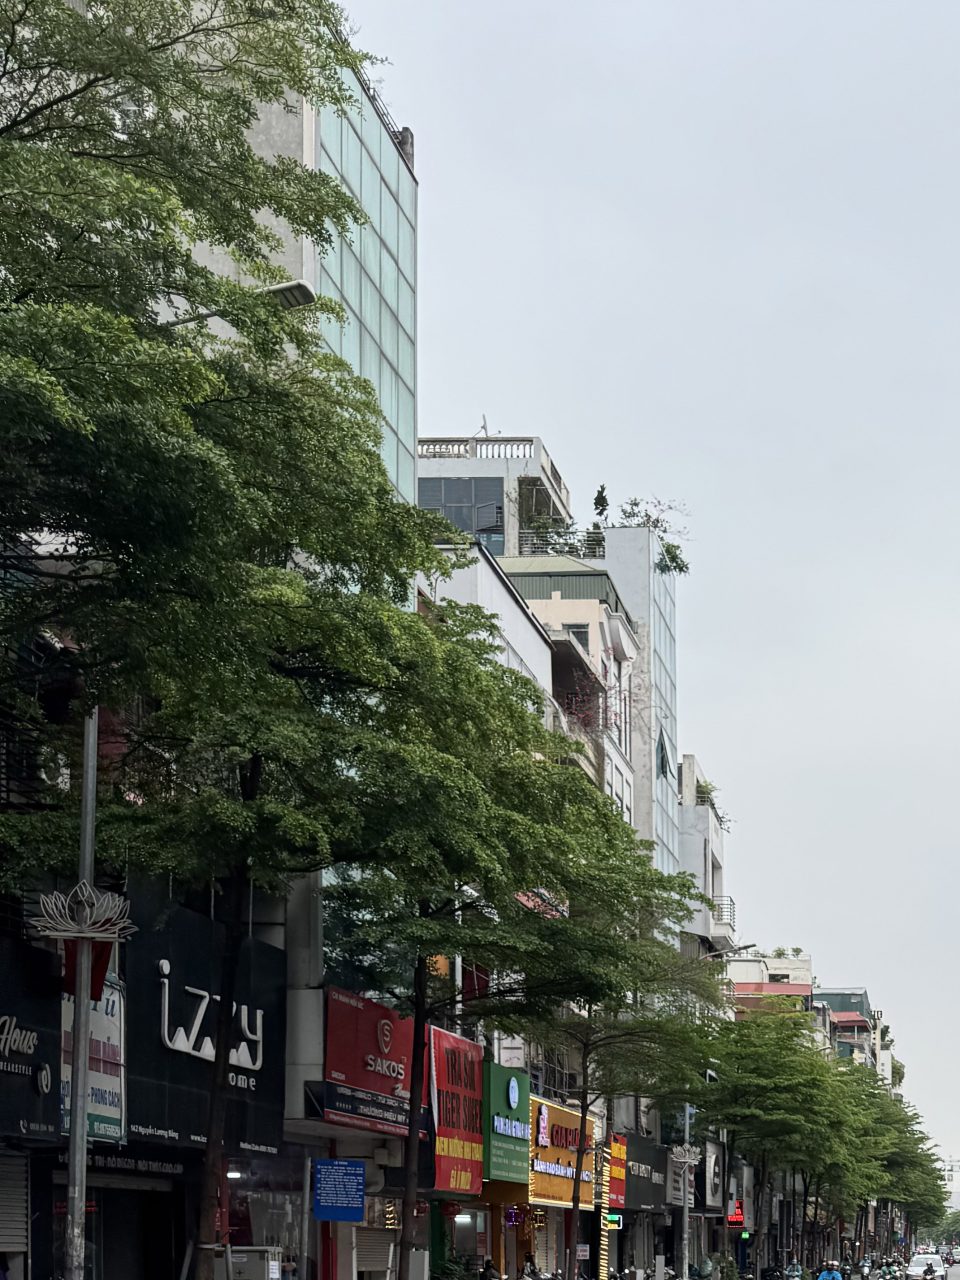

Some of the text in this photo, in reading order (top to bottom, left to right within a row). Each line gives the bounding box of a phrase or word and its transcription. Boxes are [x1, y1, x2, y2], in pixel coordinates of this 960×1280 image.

[159, 959, 263, 1071] izy
[229, 1072, 255, 1090] ome
[366, 1054, 405, 1080] SAKOS
[437, 1088, 460, 1130] TIGER
